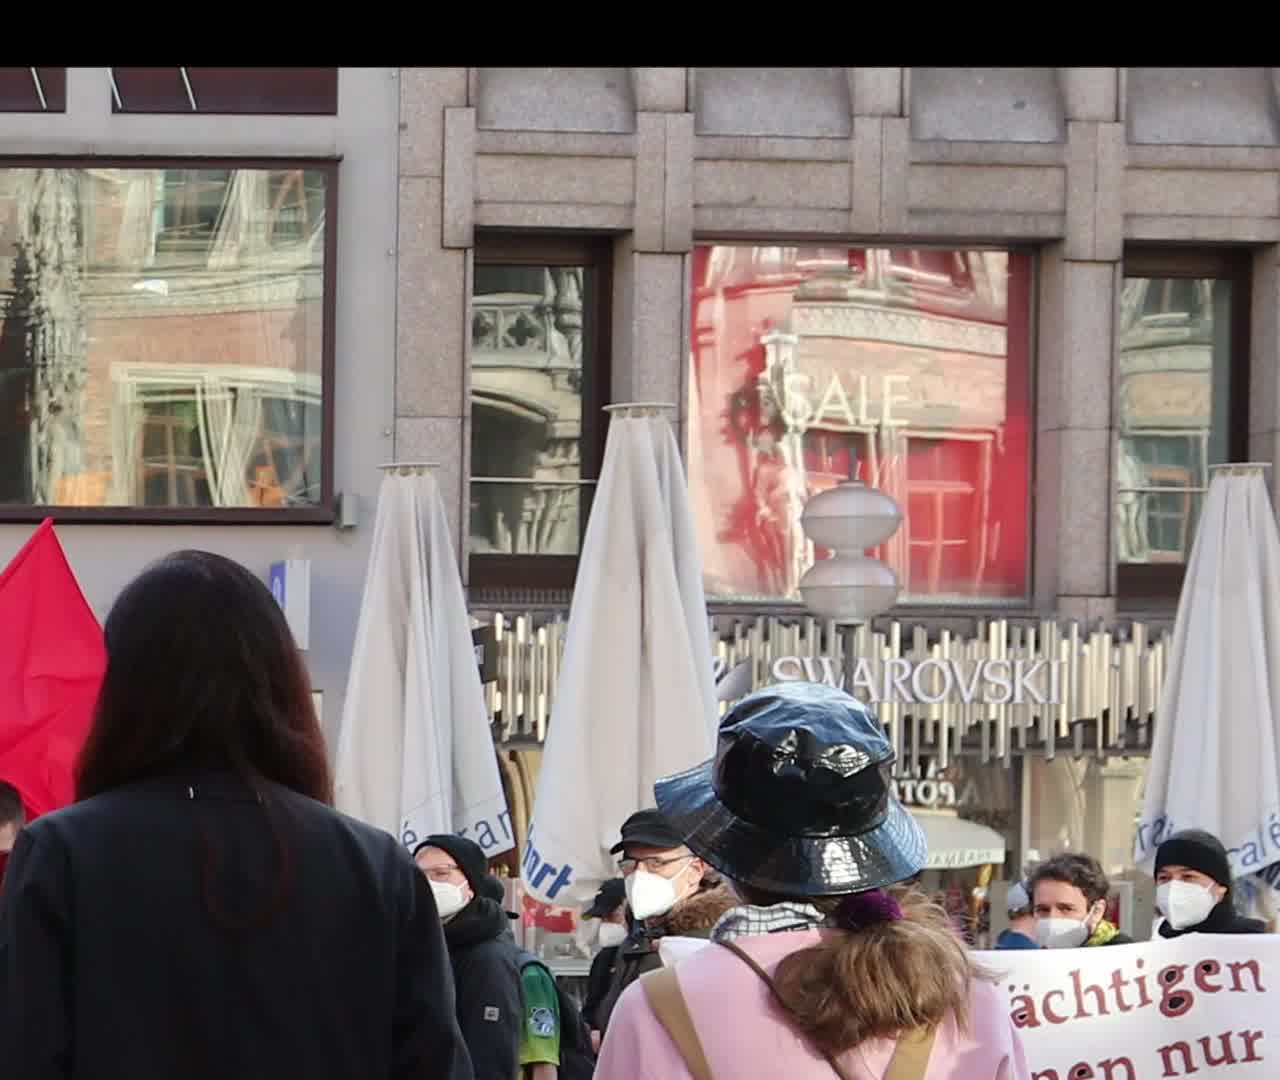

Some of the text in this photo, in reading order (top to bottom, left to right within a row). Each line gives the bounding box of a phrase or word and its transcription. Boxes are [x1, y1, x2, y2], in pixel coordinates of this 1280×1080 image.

[783, 373, 911, 425] SALE
[772, 655, 1064, 704] SWAROVSKI
[1156, 1029, 1266, 1078] nur
